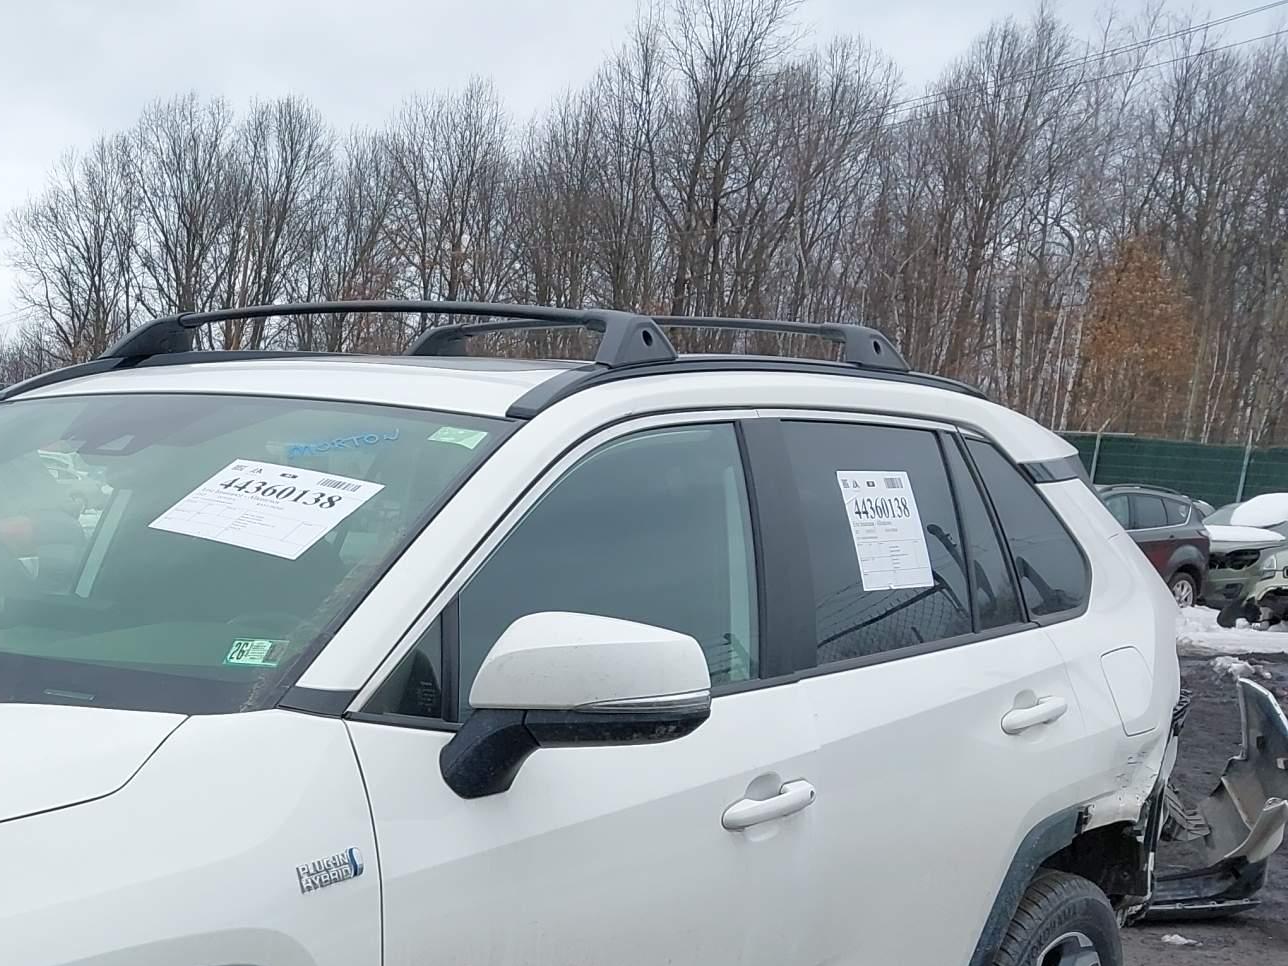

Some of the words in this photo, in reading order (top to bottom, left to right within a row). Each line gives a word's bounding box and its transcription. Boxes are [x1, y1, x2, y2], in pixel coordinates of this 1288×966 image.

[288, 427, 400, 460] MORTON
[219, 477, 341, 509] 44360138
[854, 496, 911, 520] 44360138
[228, 641, 249, 660] 26
[296, 852, 349, 877] PLUG-IN
[300, 867, 352, 894] HYBRID
